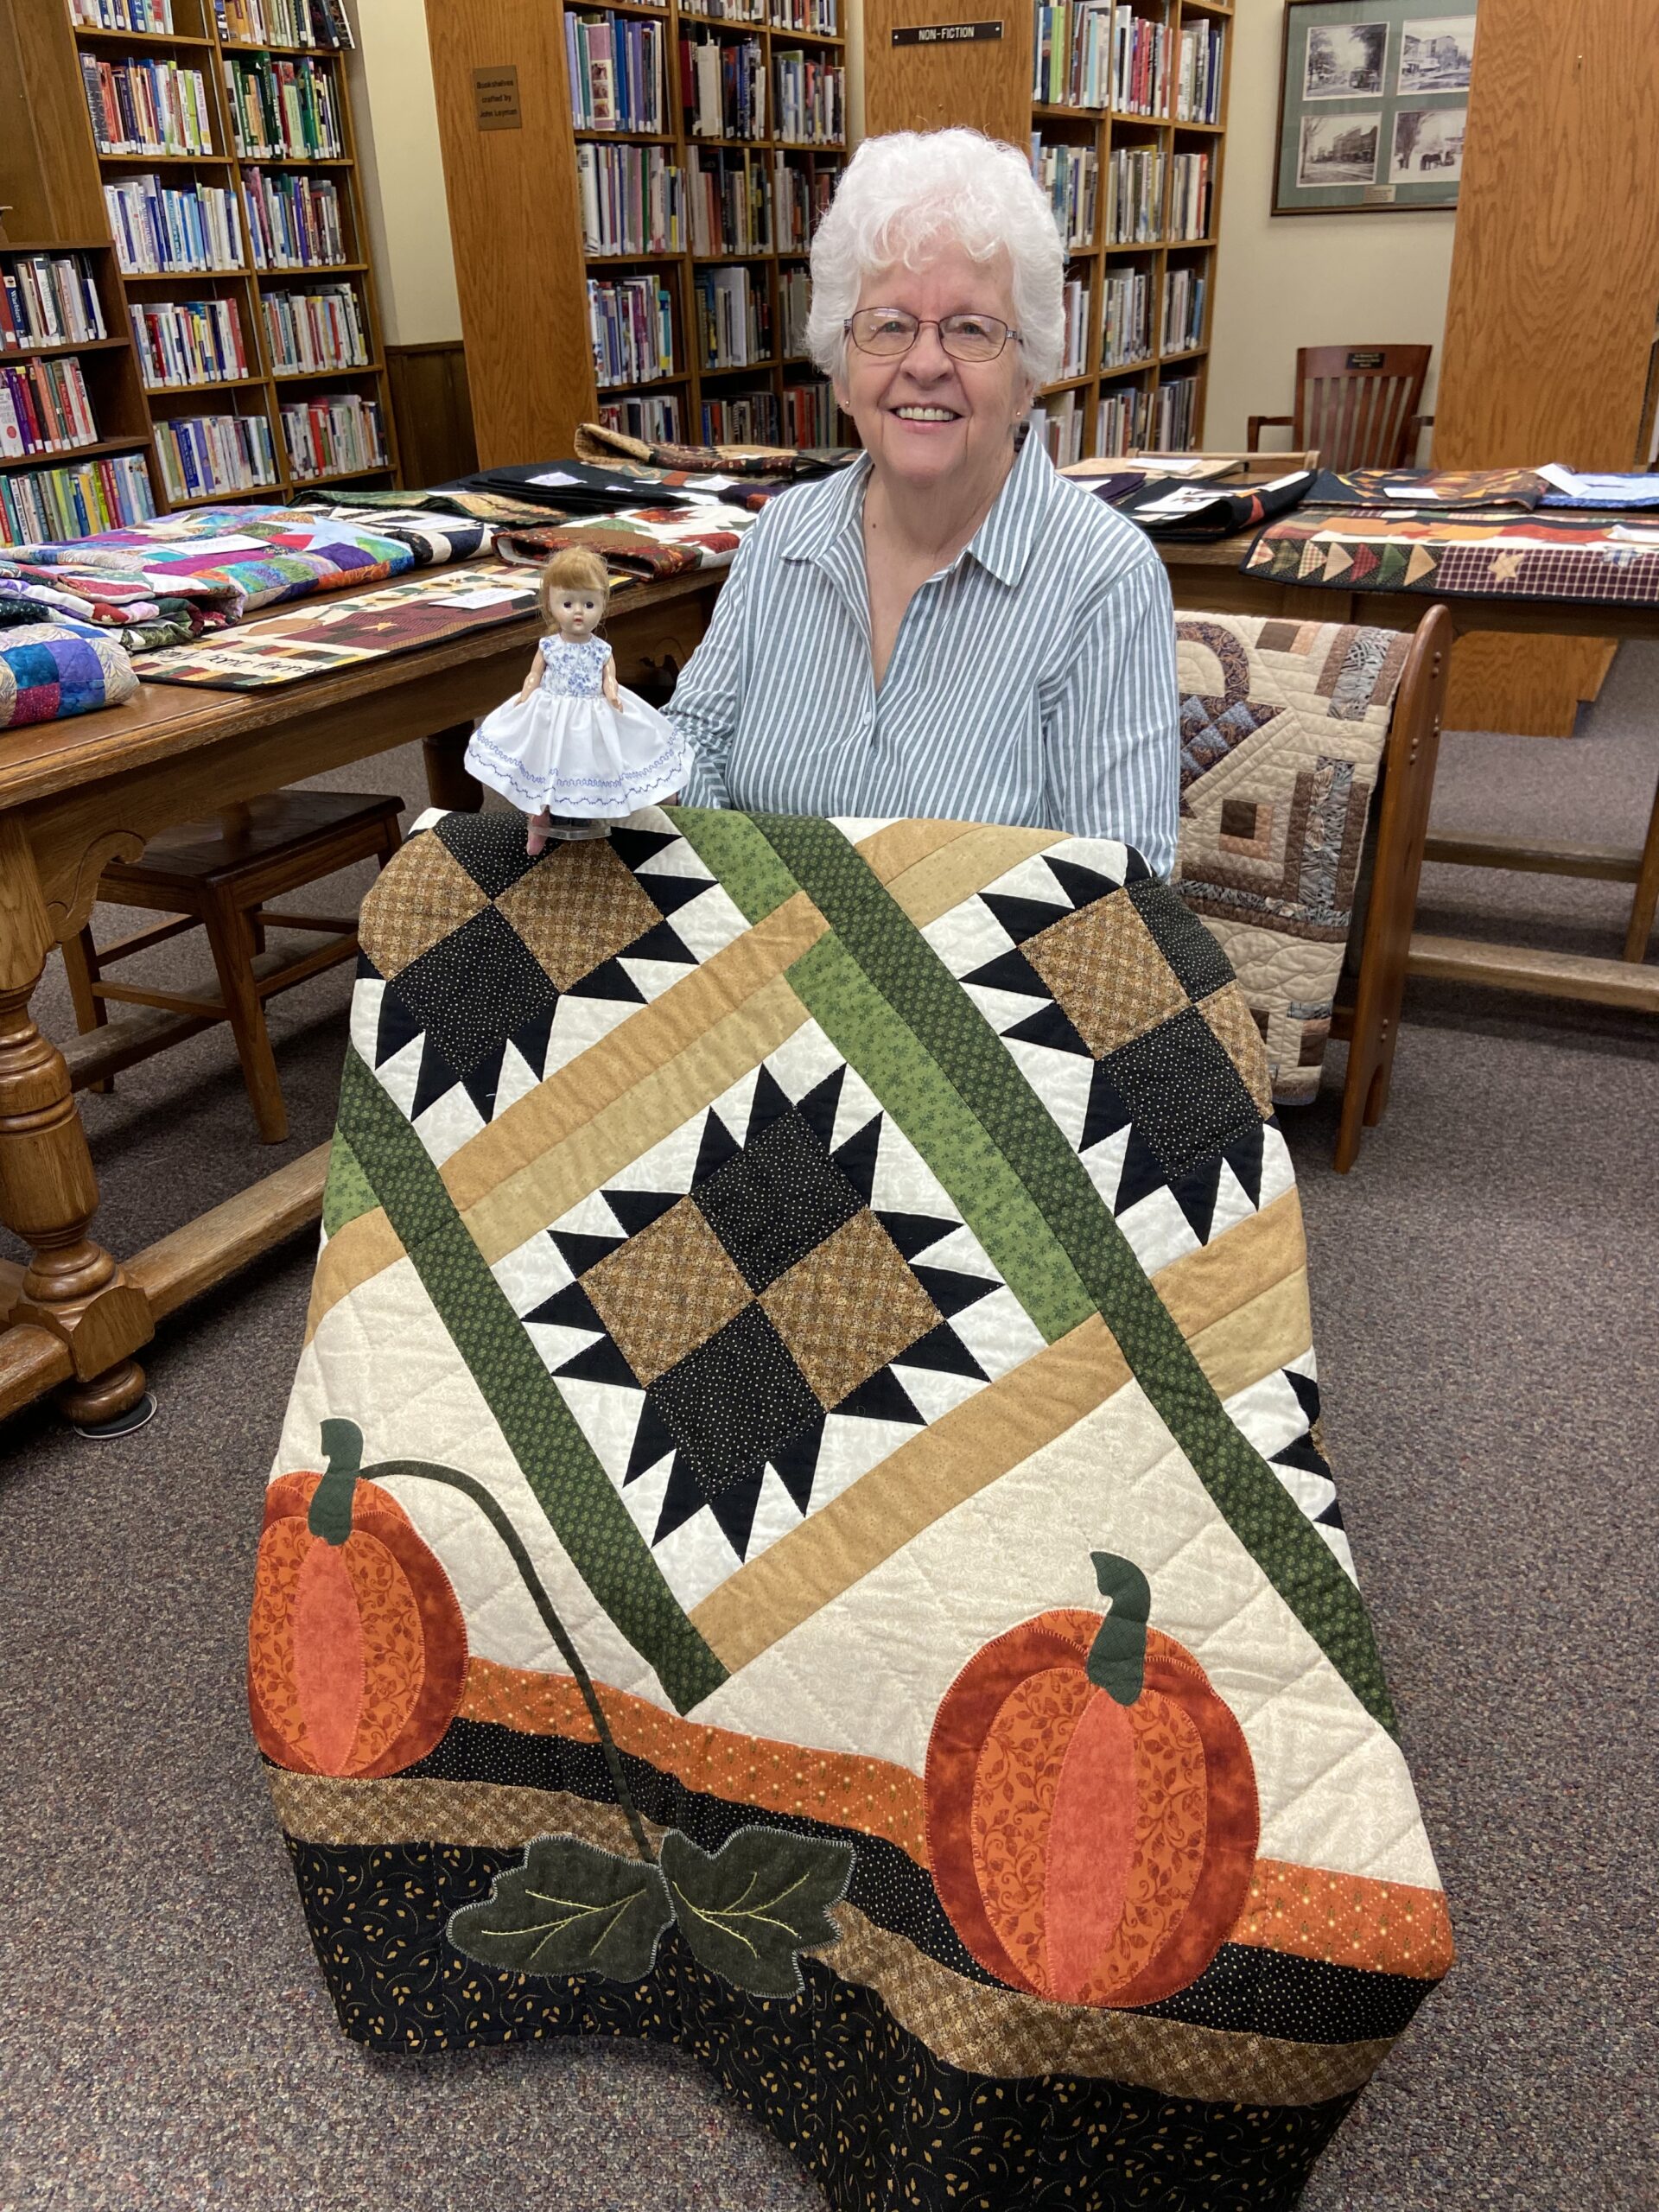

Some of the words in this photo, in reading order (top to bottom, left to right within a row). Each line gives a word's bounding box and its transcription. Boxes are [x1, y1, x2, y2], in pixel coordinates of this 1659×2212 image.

[918, 27, 975, 41] NON-FICTION
[477, 80, 513, 89] Bookshelves
[10, 290, 22, 323] Warblers
